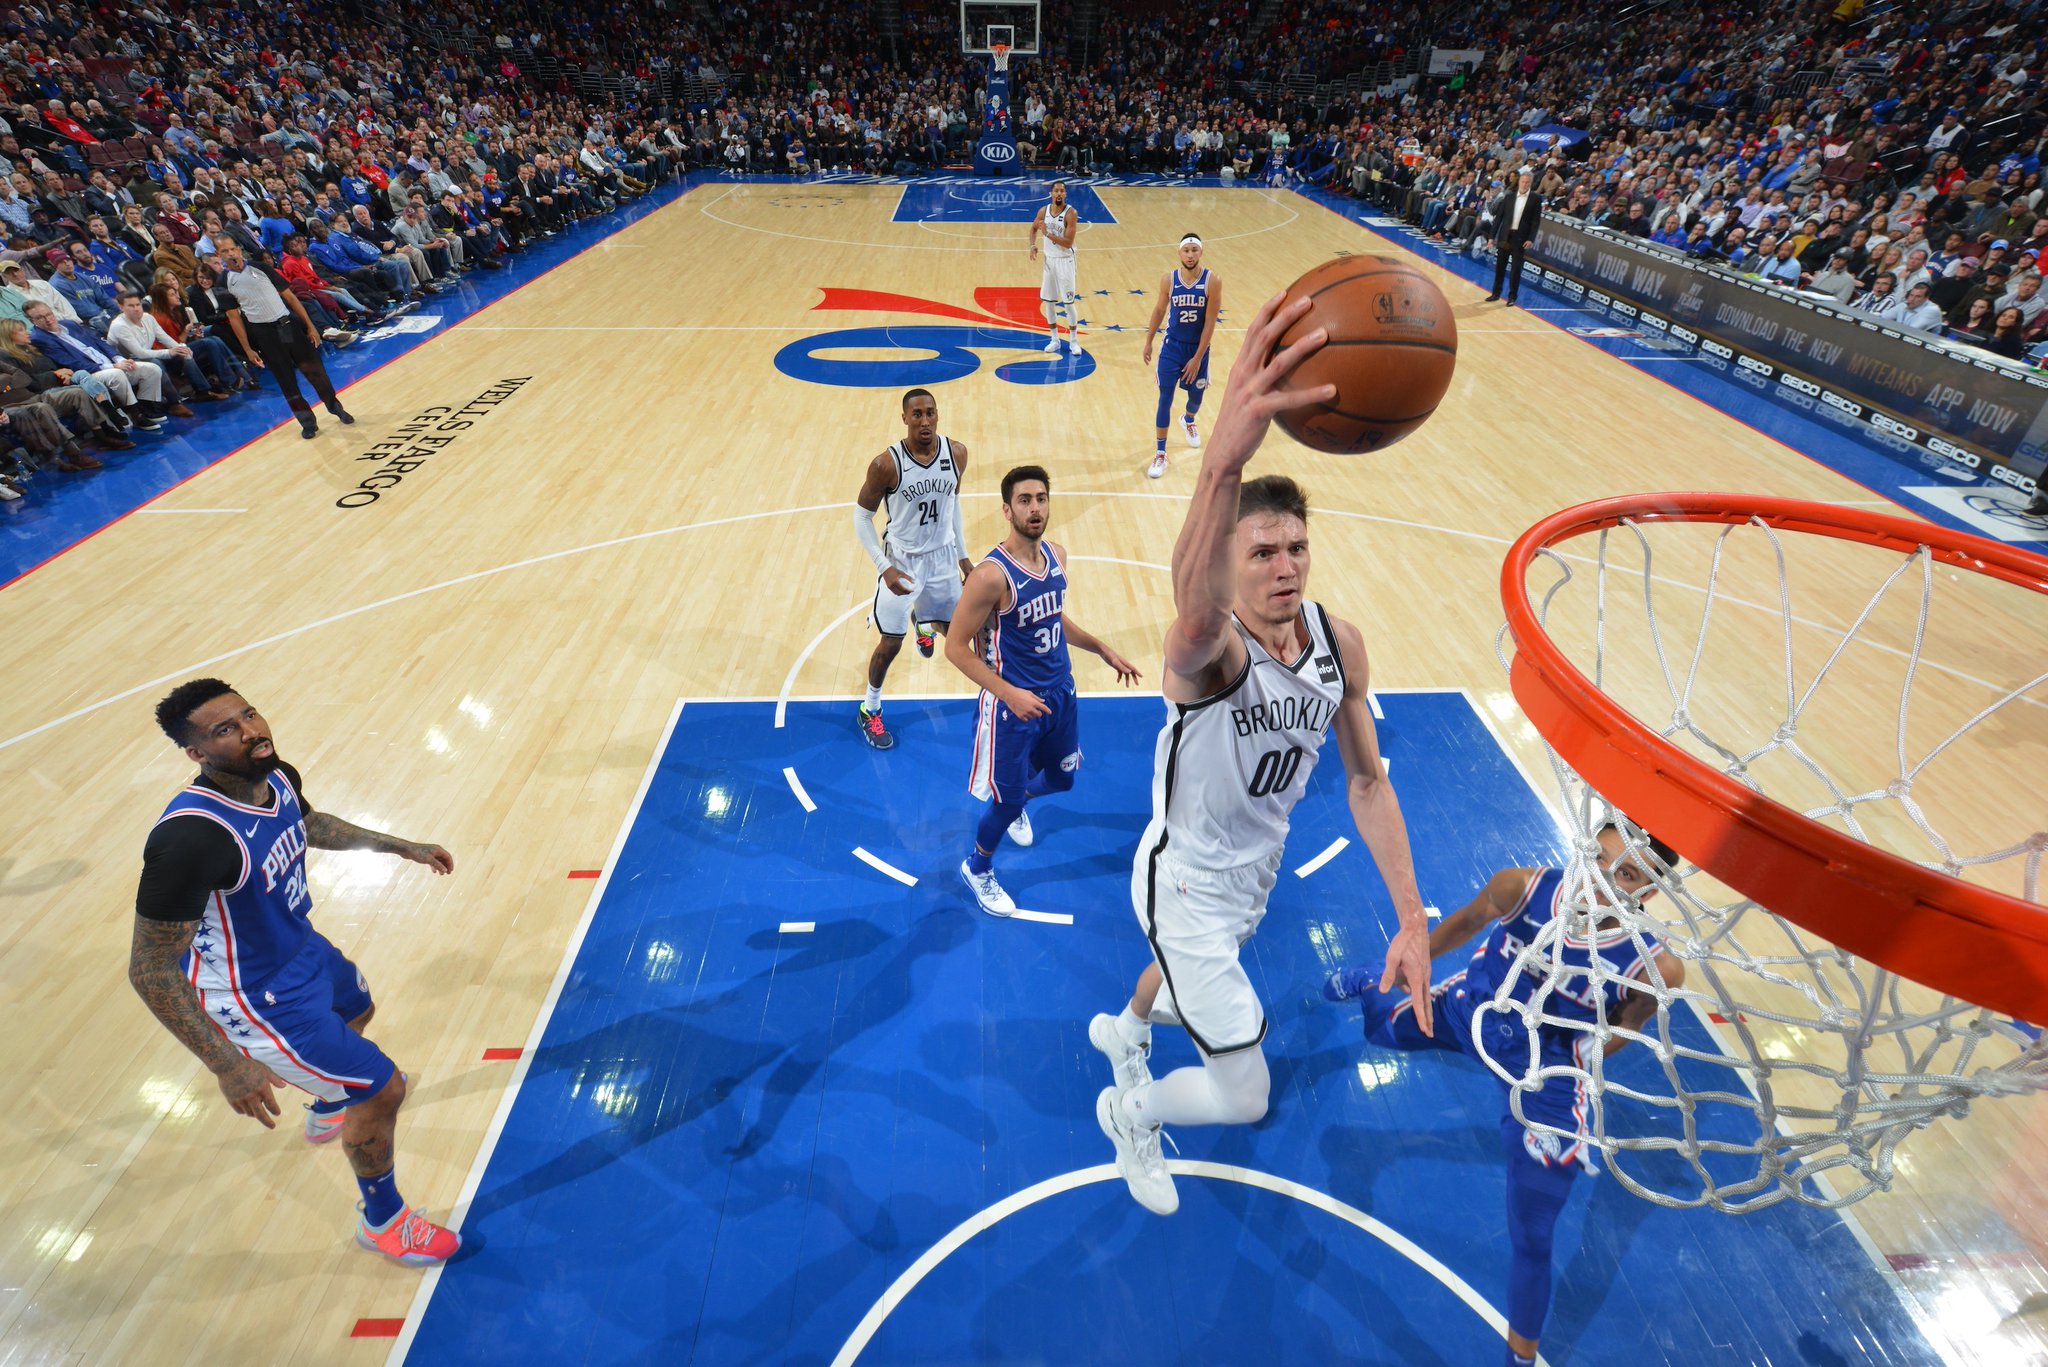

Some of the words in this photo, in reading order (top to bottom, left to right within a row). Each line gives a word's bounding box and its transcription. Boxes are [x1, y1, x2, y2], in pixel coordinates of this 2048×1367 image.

[986, 146, 1010, 158] KIA
[1593, 251, 1629, 286] YOUR
[1179, 310, 1198, 324] 25
[1523, 260, 1541, 275] GEICO
[1544, 270, 1565, 285] GEICO
[1565, 278, 1584, 294] GEICO
[1588, 289, 1611, 306] GEICO
[1612, 299, 1637, 317] GEICO
[1640, 311, 1668, 331] GEICO
[1670, 324, 1698, 344] GEICO
[1701, 339, 1733, 360] GEICO
[1737, 354, 1774, 377] GEICO
[1780, 372, 1821, 397] GEICO
[1821, 390, 1862, 417] GEICO
[1870, 412, 1918, 441] GEICO
[1926, 437, 1982, 468] GEICO
[1990, 464, 2037, 494] GEIC
[1715, 303, 1779, 341] DOWNLOAD
[1781, 327, 1807, 352] THE
[1808, 338, 1843, 366] NEW
[1846, 352, 1924, 397] MYTEAMS
[1924, 383, 1966, 412] APP
[1966, 398, 2019, 434] NOW
[1948, 351, 1970, 364] GEICO
[1973, 359, 1996, 372] GEICO
[1999, 368, 2023, 381] GEICO
[436, 375, 533, 432] WELLS
[354, 406, 452, 461] CENTER
[336, 434, 457, 509] FARGO
[901, 478, 953, 503] BROOKLYN
[918, 499, 939, 527] 24
[1034, 621, 1061, 654] 30
[1248, 745, 1303, 798] 00
